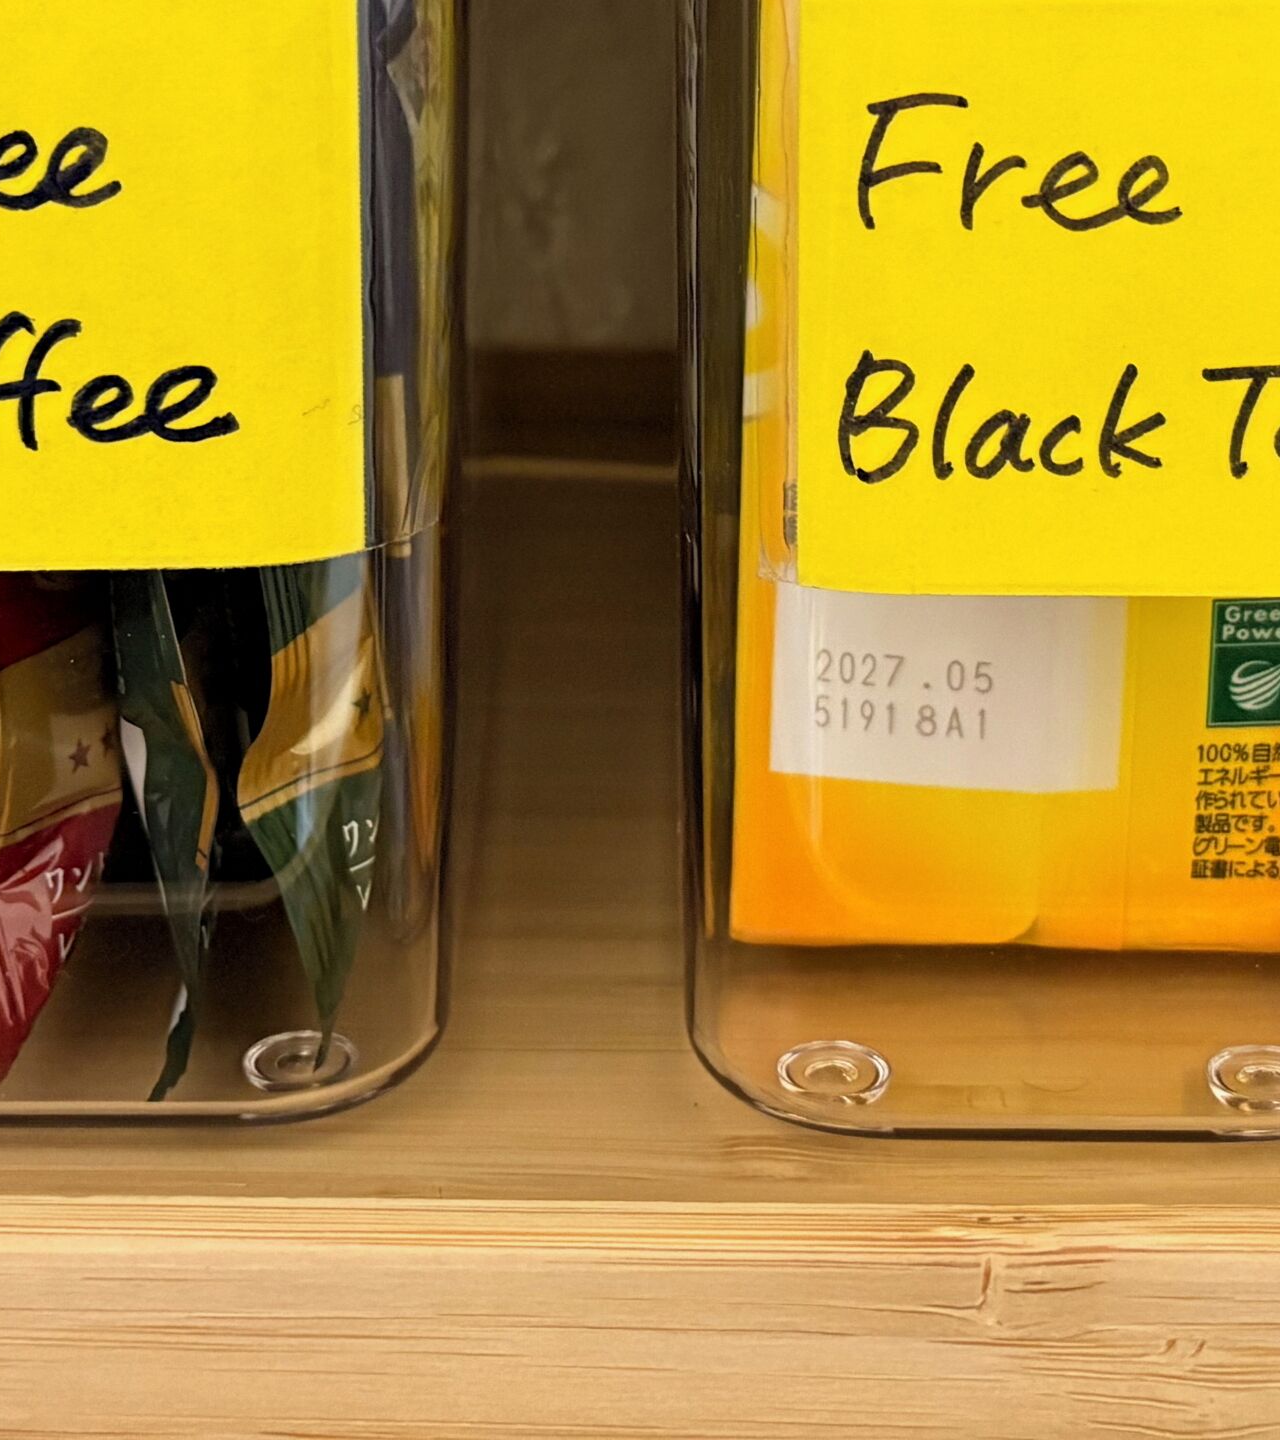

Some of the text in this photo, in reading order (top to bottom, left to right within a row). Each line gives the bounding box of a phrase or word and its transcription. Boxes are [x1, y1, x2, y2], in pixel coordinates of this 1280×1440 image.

[856, 92, 1183, 231] Free
[837, 349, 1166, 484] Black
[1194, 812, 1276, 834] 製品です。
